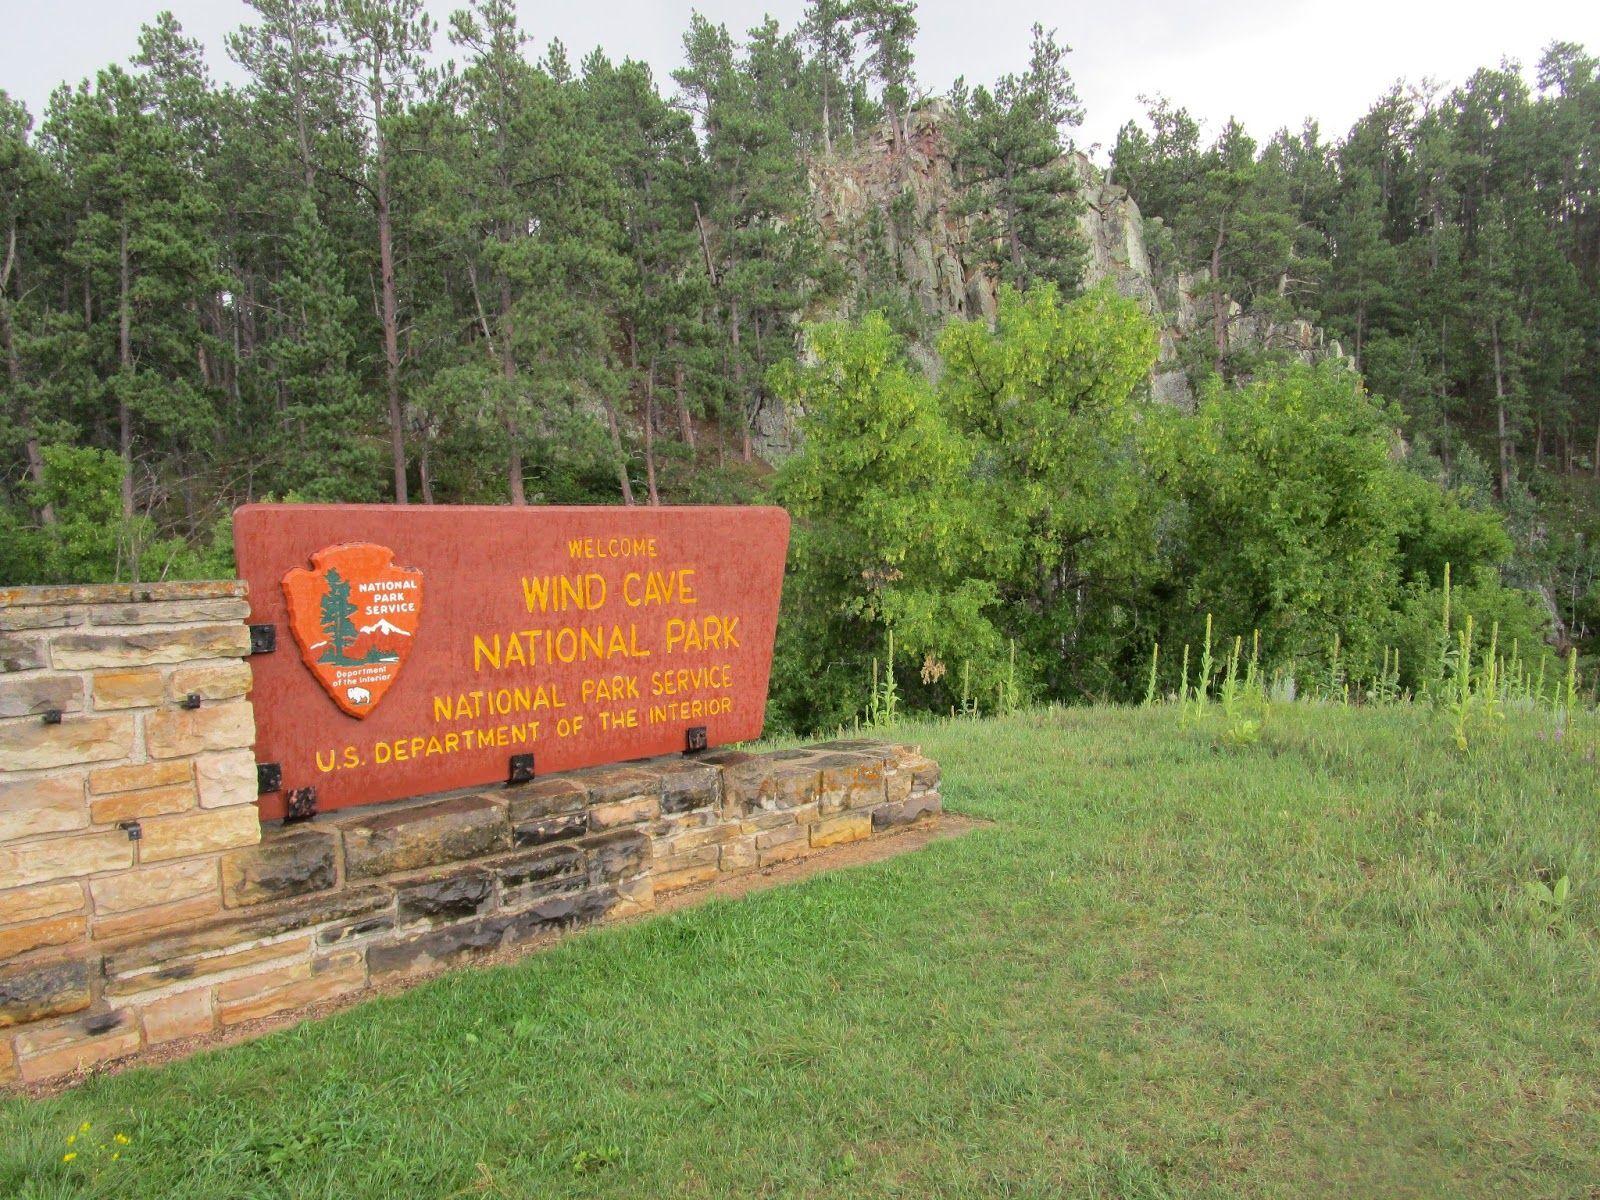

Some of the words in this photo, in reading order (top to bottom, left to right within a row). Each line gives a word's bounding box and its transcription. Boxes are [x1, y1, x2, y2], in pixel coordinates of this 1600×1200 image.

[568, 537, 657, 559] WELCOME
[359, 581, 417, 592] NATIONAL
[521, 572, 608, 613] WIND
[623, 568, 699, 607] CAVE
[373, 592, 405, 603] PARK
[366, 603, 415, 615] SERVICE
[472, 627, 651, 672] NATIONAL
[665, 615, 741, 655] PARK
[336, 666, 387, 678] Department
[332, 679, 342, 687] of
[432, 684, 567, 723] NATIONAL
[580, 672, 640, 703] PARK
[651, 663, 734, 696] SERVICE
[315, 744, 367, 773] U.S.
[373, 721, 541, 765] DEPARTMENT
[556, 715, 585, 738] OF
[599, 706, 639, 731] THE
[648, 696, 733, 726] INTERIOR
